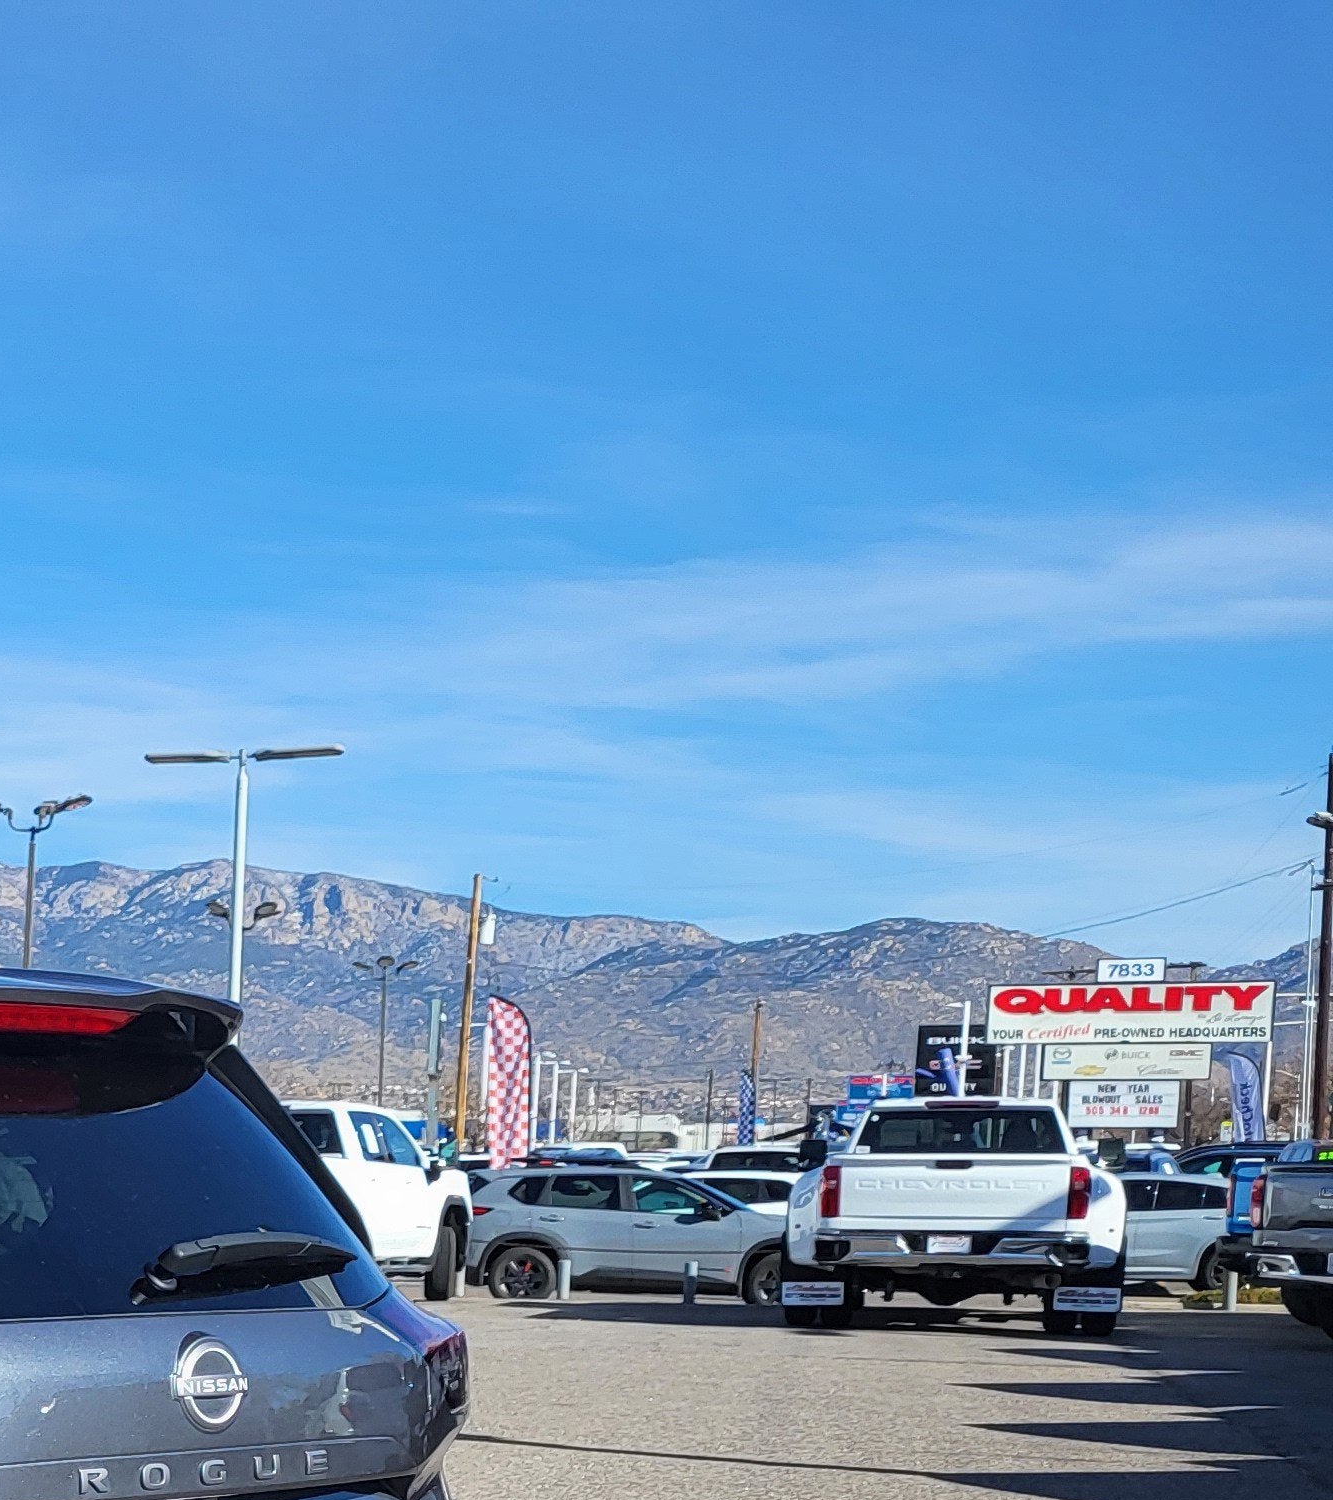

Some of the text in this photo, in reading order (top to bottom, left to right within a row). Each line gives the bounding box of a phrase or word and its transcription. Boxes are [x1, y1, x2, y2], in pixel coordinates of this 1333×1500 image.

[1108, 963, 1155, 978] 7833
[993, 985, 1269, 1014] QUALITY
[992, 1023, 1267, 1040] YOUR Certified PRE-OWNED HEADQUARTERS
[1121, 1051, 1151, 1059] BUICK
[931, 1082, 976, 1092] QUTY
[1097, 1084, 1150, 1093] NEW YEAR
[1081, 1095, 1164, 1104] BLOWOUT SALES
[853, 1179, 1052, 1193] CHEVROLET
[179, 1377, 248, 1394] NISSAN
[78, 1449, 330, 1495] ROGUE
